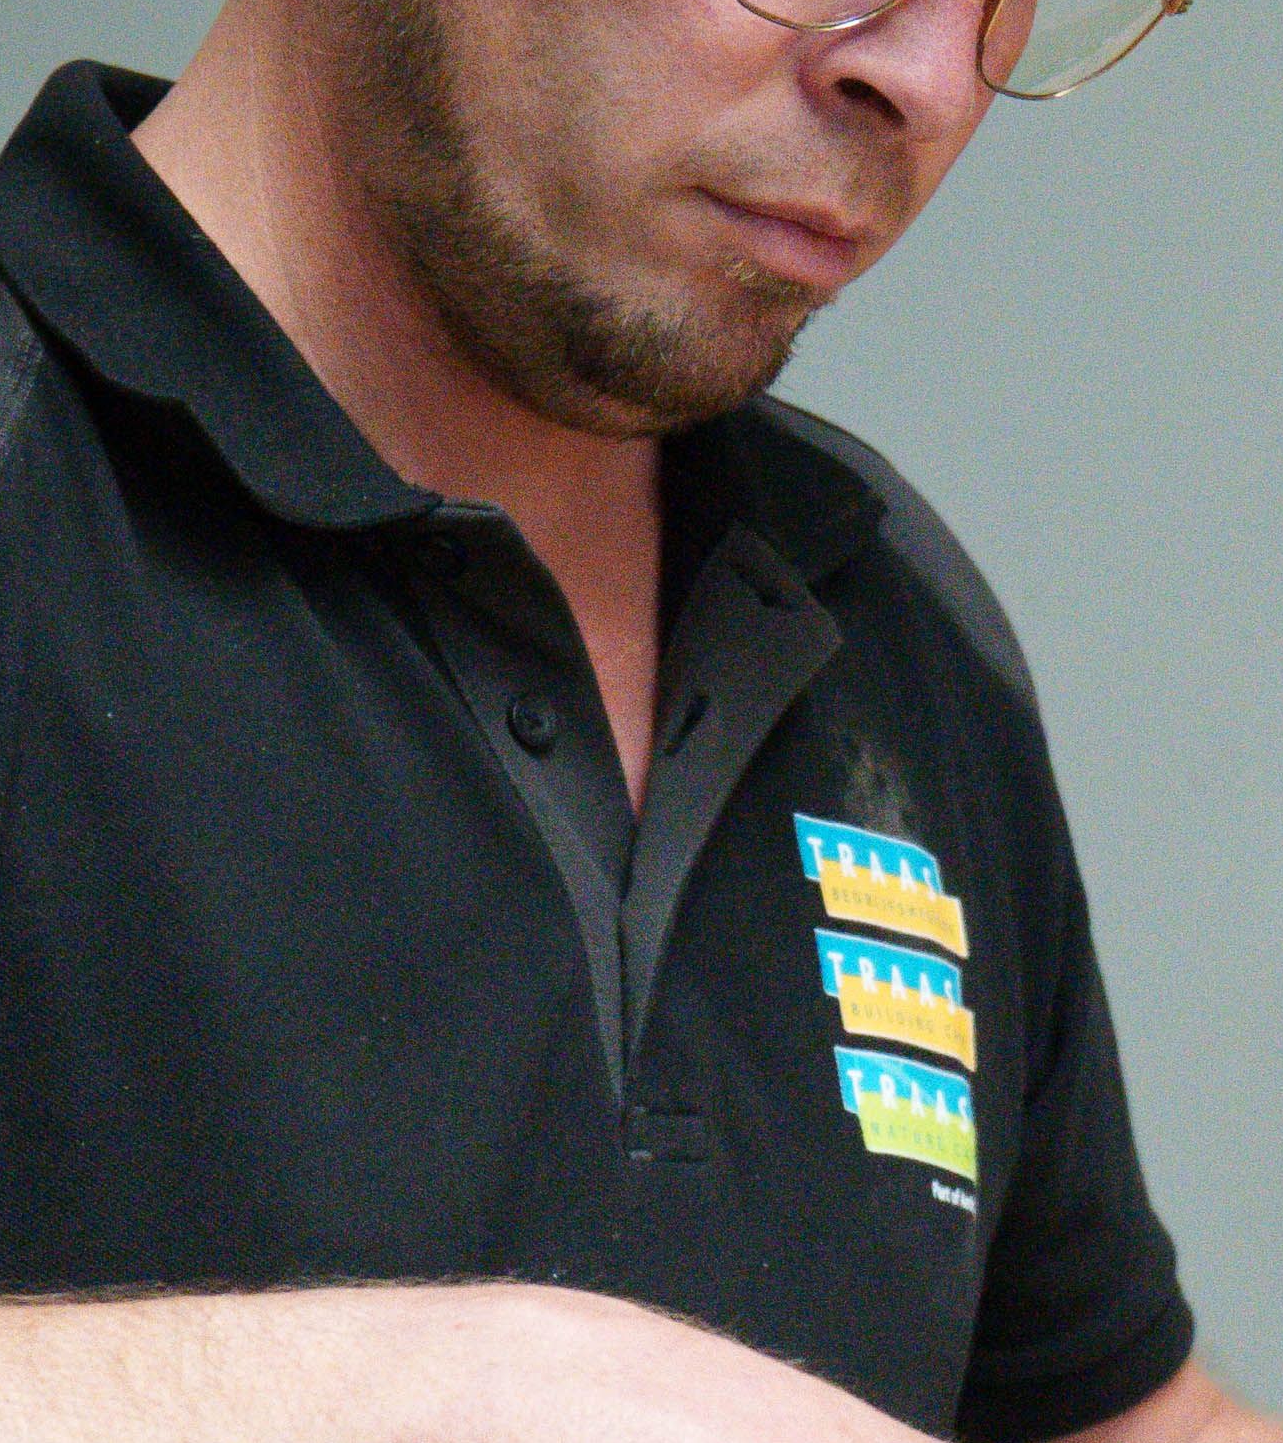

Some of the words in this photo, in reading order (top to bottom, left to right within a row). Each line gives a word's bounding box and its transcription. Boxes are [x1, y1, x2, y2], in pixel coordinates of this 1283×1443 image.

[806, 835, 939, 903] TRAAS
[826, 950, 958, 1015] TRAAS
[846, 1067, 971, 1135] TRAAS
